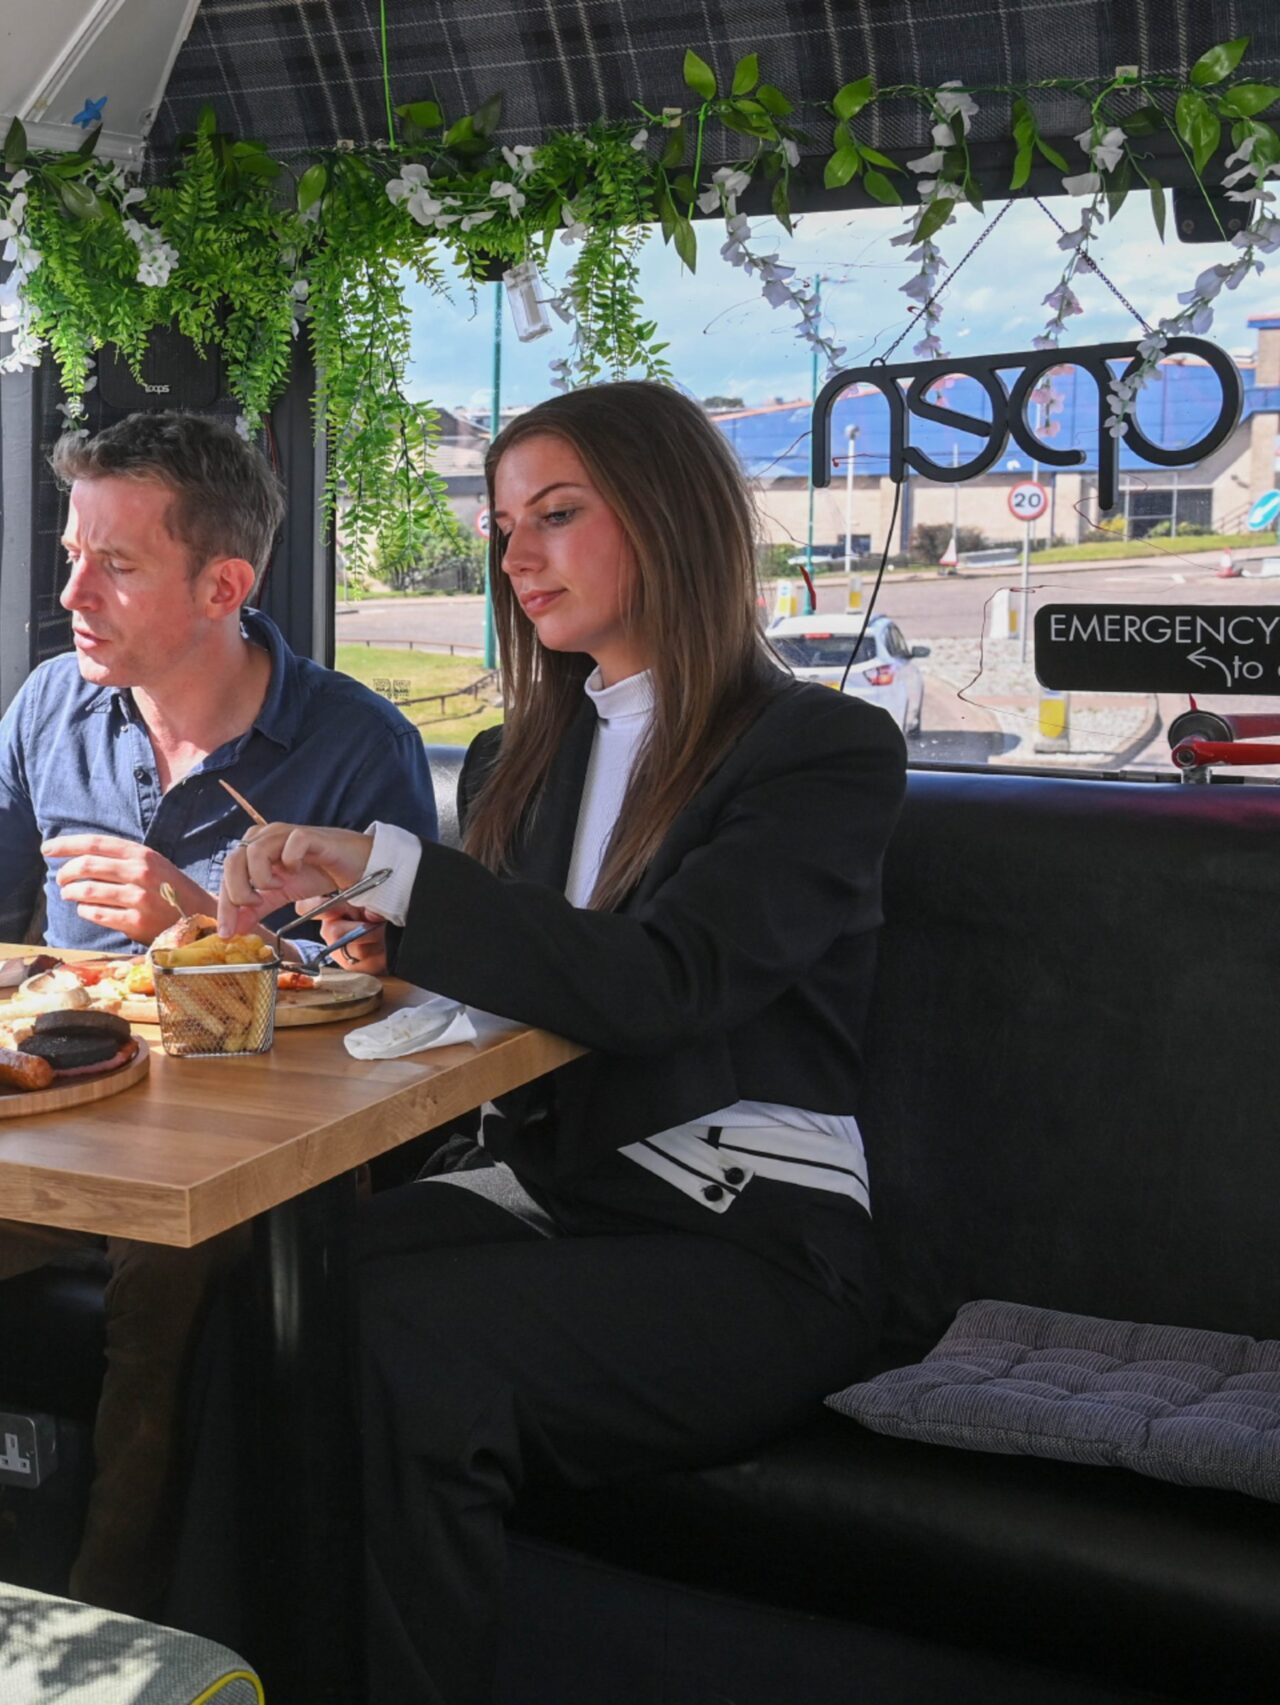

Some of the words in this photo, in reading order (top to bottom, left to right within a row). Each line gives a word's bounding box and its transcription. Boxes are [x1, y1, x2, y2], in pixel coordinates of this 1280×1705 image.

[1014, 492, 1041, 508] 20
[1050, 614, 1280, 645] EMERGENCY
[1232, 655, 1263, 679] to
